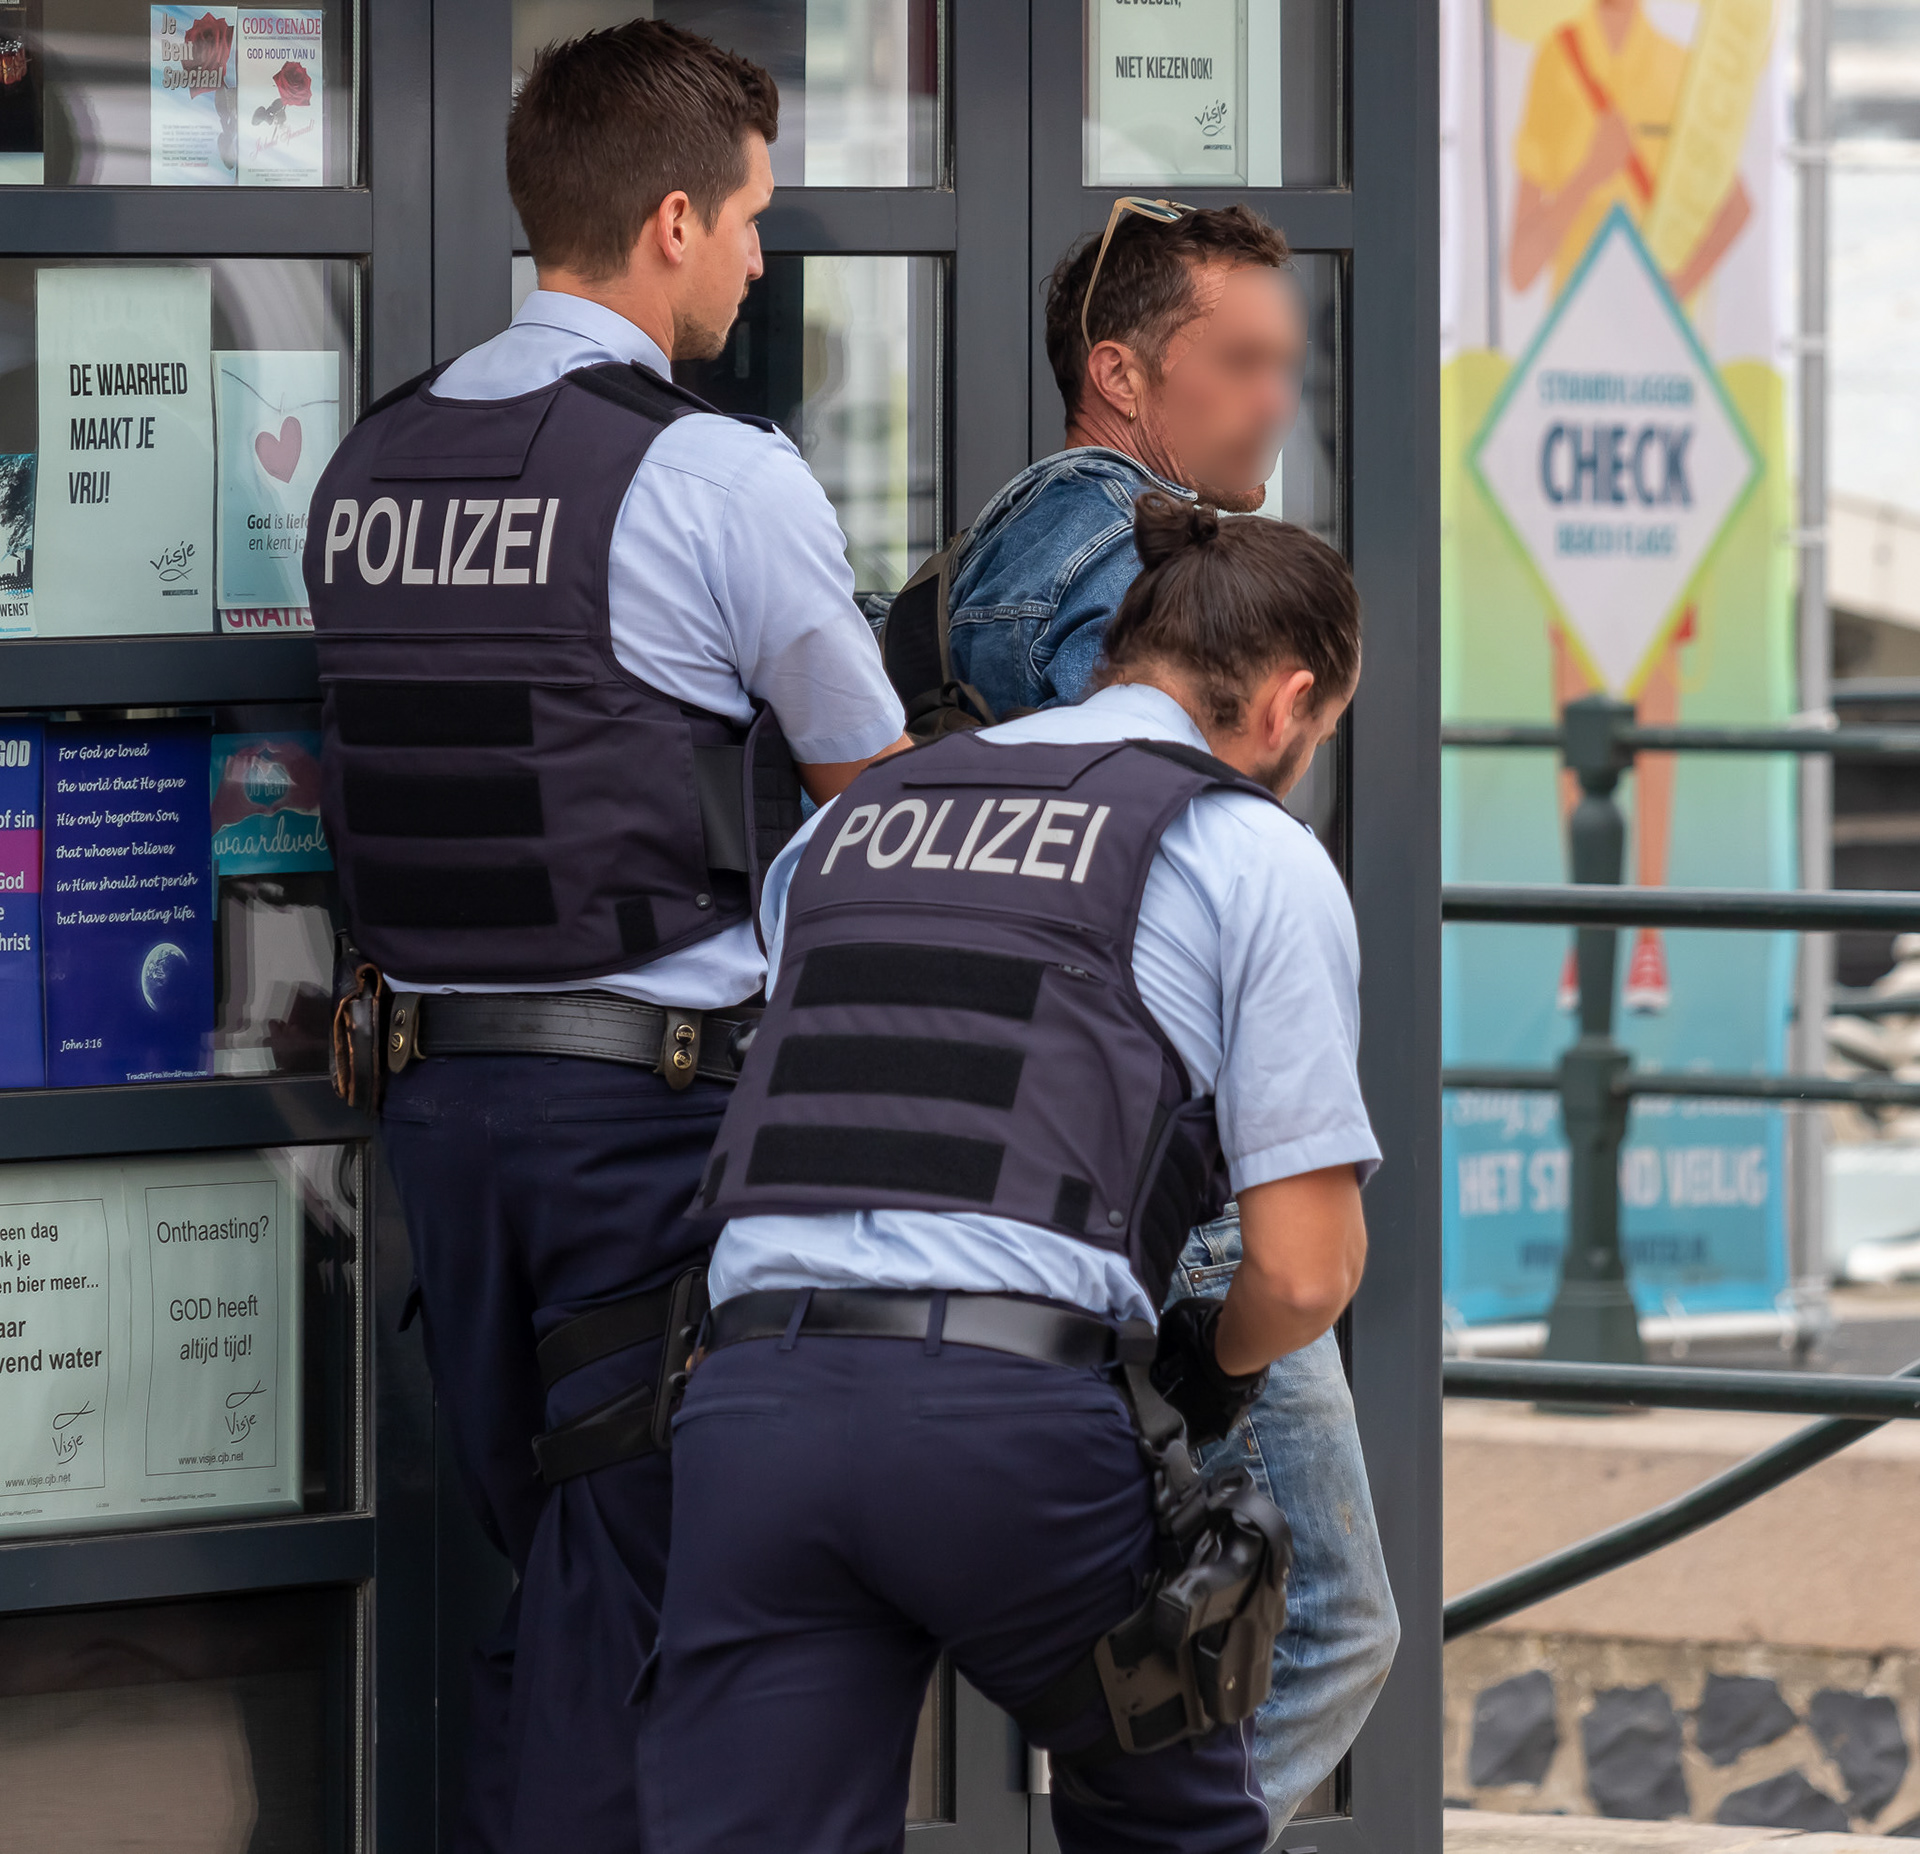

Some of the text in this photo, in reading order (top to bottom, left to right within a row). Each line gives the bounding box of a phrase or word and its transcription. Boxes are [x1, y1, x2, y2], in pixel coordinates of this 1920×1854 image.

[161, 13, 177, 35] Je
[242, 17, 321, 35] GODS GENADE
[161, 40, 194, 61] Bent
[247, 48, 315, 59] GOD HOUDT VAN U
[162, 66, 224, 90] Speciaal
[1116, 56, 1213, 80] NIET KIEZEN OOK!
[70, 362, 188, 397] DE WAARHEID
[70, 416, 156, 451] MAAKT JE
[1541, 422, 1694, 510] CHECK
[68, 471, 110, 504] VRIJ!
[247, 513, 271, 530] God
[274, 517, 283, 530] is
[249, 537, 263, 551] en
[266, 535, 291, 550] kent
[324, 497, 560, 586] POLIZEI
[59, 743, 150, 762] For God so loved
[57, 776, 186, 793] the world that He gave
[14, 809, 35, 829] sin
[57, 809, 179, 828] His only begotten Son,
[56, 841, 176, 859] that whoever believes
[820, 799, 1110, 883] POLIZEI
[56, 872, 199, 892] in Him should not perish
[56, 905, 196, 925] but have everlasting life.
[60, 1038, 103, 1053] John 3:16
[30, 1221, 59, 1242] dag
[156, 1215, 270, 1244] Onthaasting?
[16, 1249, 31, 1271] je
[0, 1275, 99, 1294] n bier meer...
[169, 1294, 259, 1322] GOD heeft
[49, 1347, 102, 1371] water
[179, 1334, 252, 1365] altijd tijd!
[225, 1411, 257, 1444] Visje
[51, 1432, 84, 1465] Visje
[178, 1451, 245, 1466] www.visje.cjb.net
[4, 1472, 72, 1488] www.visje.cjb.net
